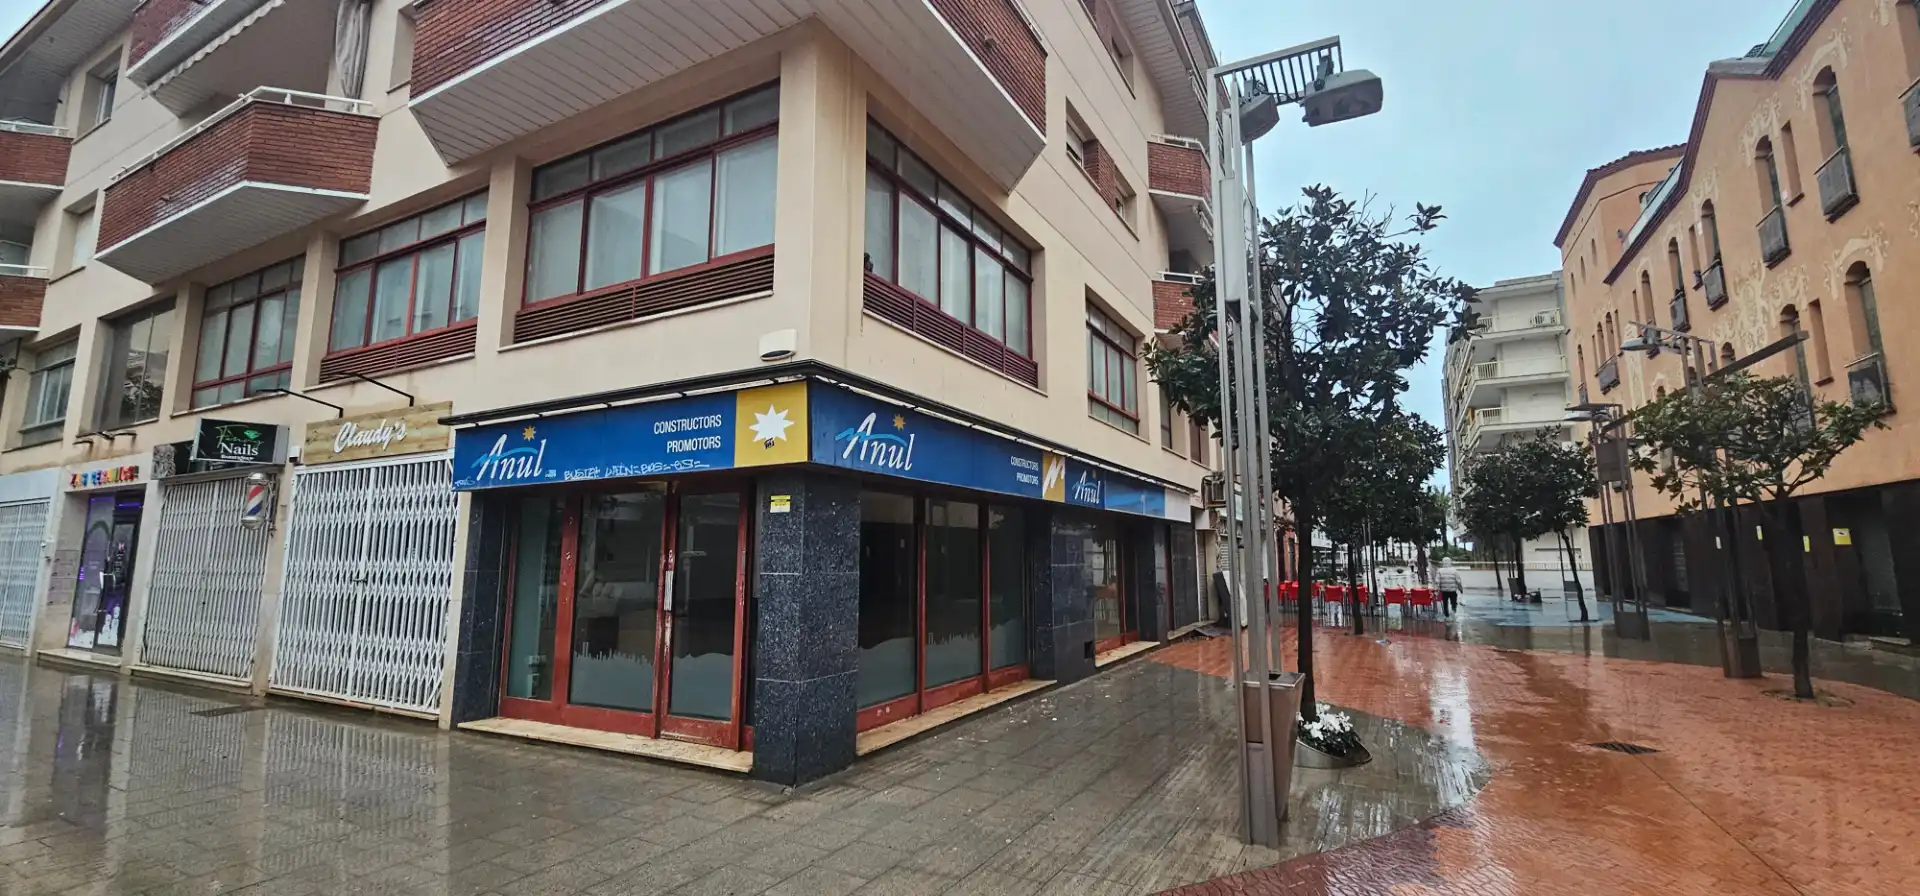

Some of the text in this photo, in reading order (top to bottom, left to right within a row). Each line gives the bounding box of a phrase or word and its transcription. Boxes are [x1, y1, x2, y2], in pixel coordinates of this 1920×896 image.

[654, 414, 722, 435] CONSTRUCTORS
[333, 419, 408, 453] Claudy's
[667, 435, 721, 454] PROMOTORS
[836, 412, 915, 471] Anul
[220, 442, 259, 456] Nails
[472, 433, 547, 481] Anul
[1010, 455, 1039, 471] CONSTRUCTORS
[1016, 472, 1039, 486] PROMOTORS
[1073, 470, 1101, 504] Anul
